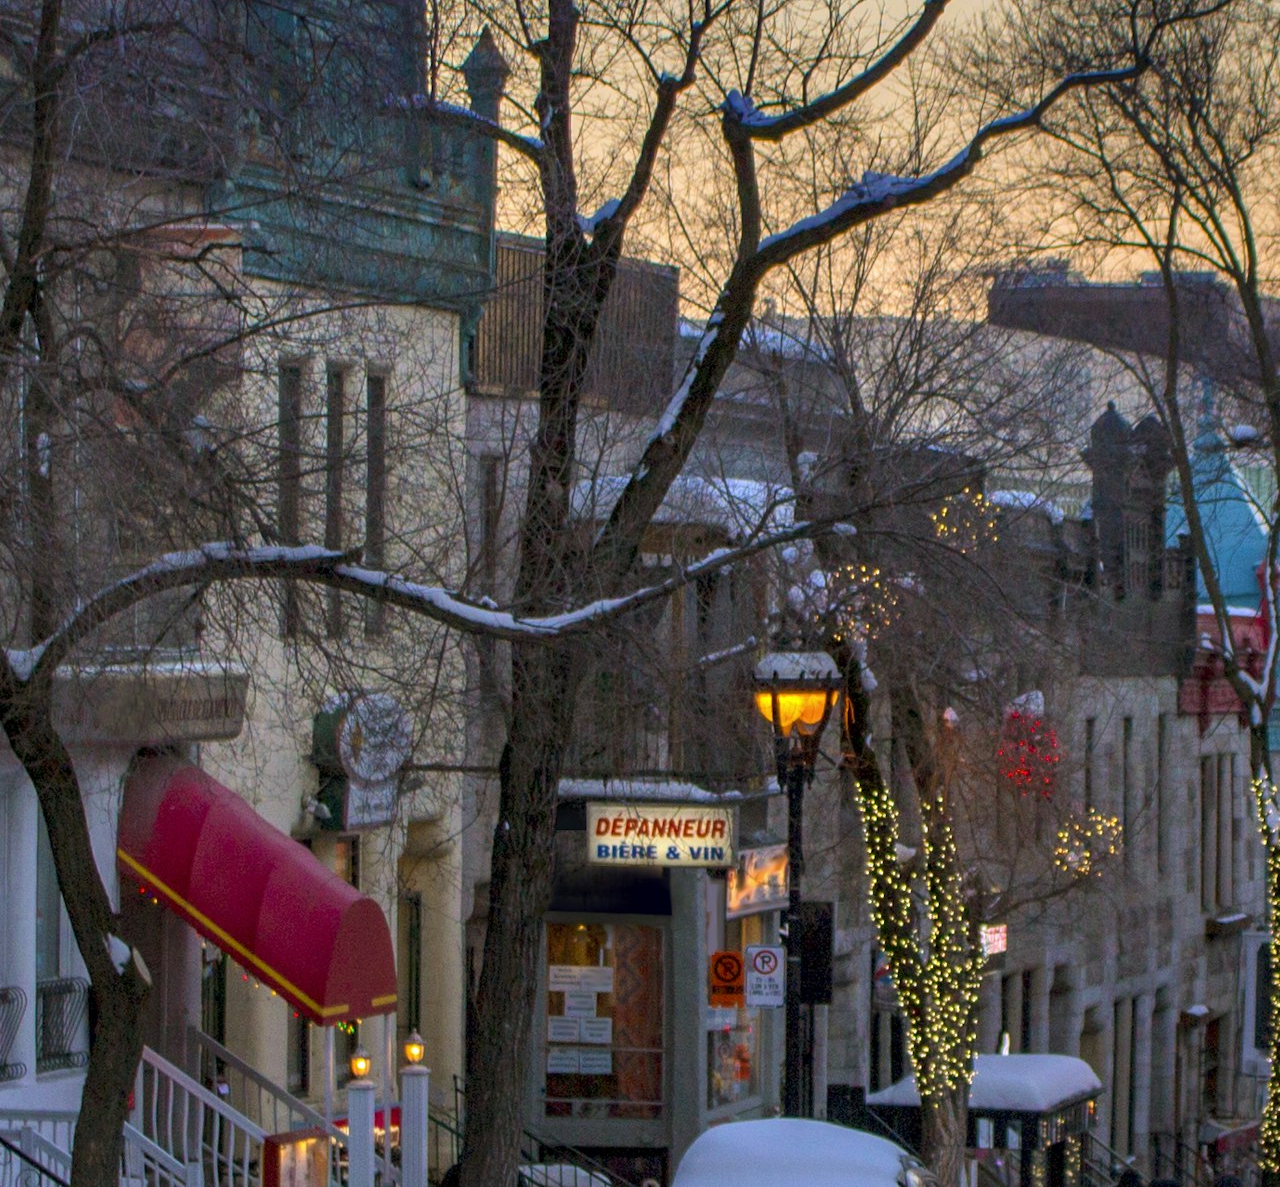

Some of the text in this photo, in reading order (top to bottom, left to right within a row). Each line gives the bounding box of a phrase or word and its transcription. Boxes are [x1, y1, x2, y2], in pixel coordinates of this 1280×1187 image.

[595, 812, 726, 838] DÉPANNEUR
[597, 840, 724, 860] BIÈRE & VIN
